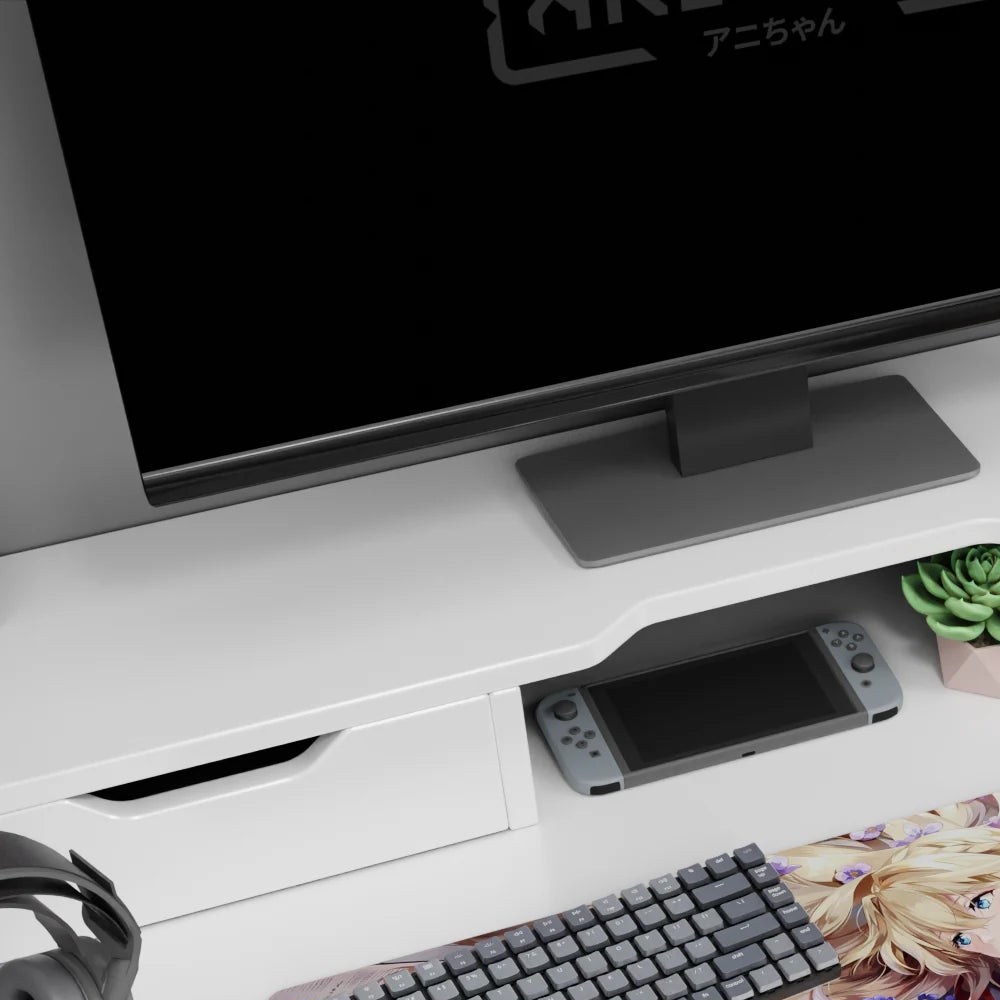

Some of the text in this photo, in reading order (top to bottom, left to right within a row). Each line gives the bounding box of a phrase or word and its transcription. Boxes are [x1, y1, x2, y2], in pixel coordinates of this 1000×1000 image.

[704, 7, 845, 57] アニちゃん
[771, 890, 787, 898] down
[731, 952, 745, 960] shift
[725, 978, 745, 989] control
